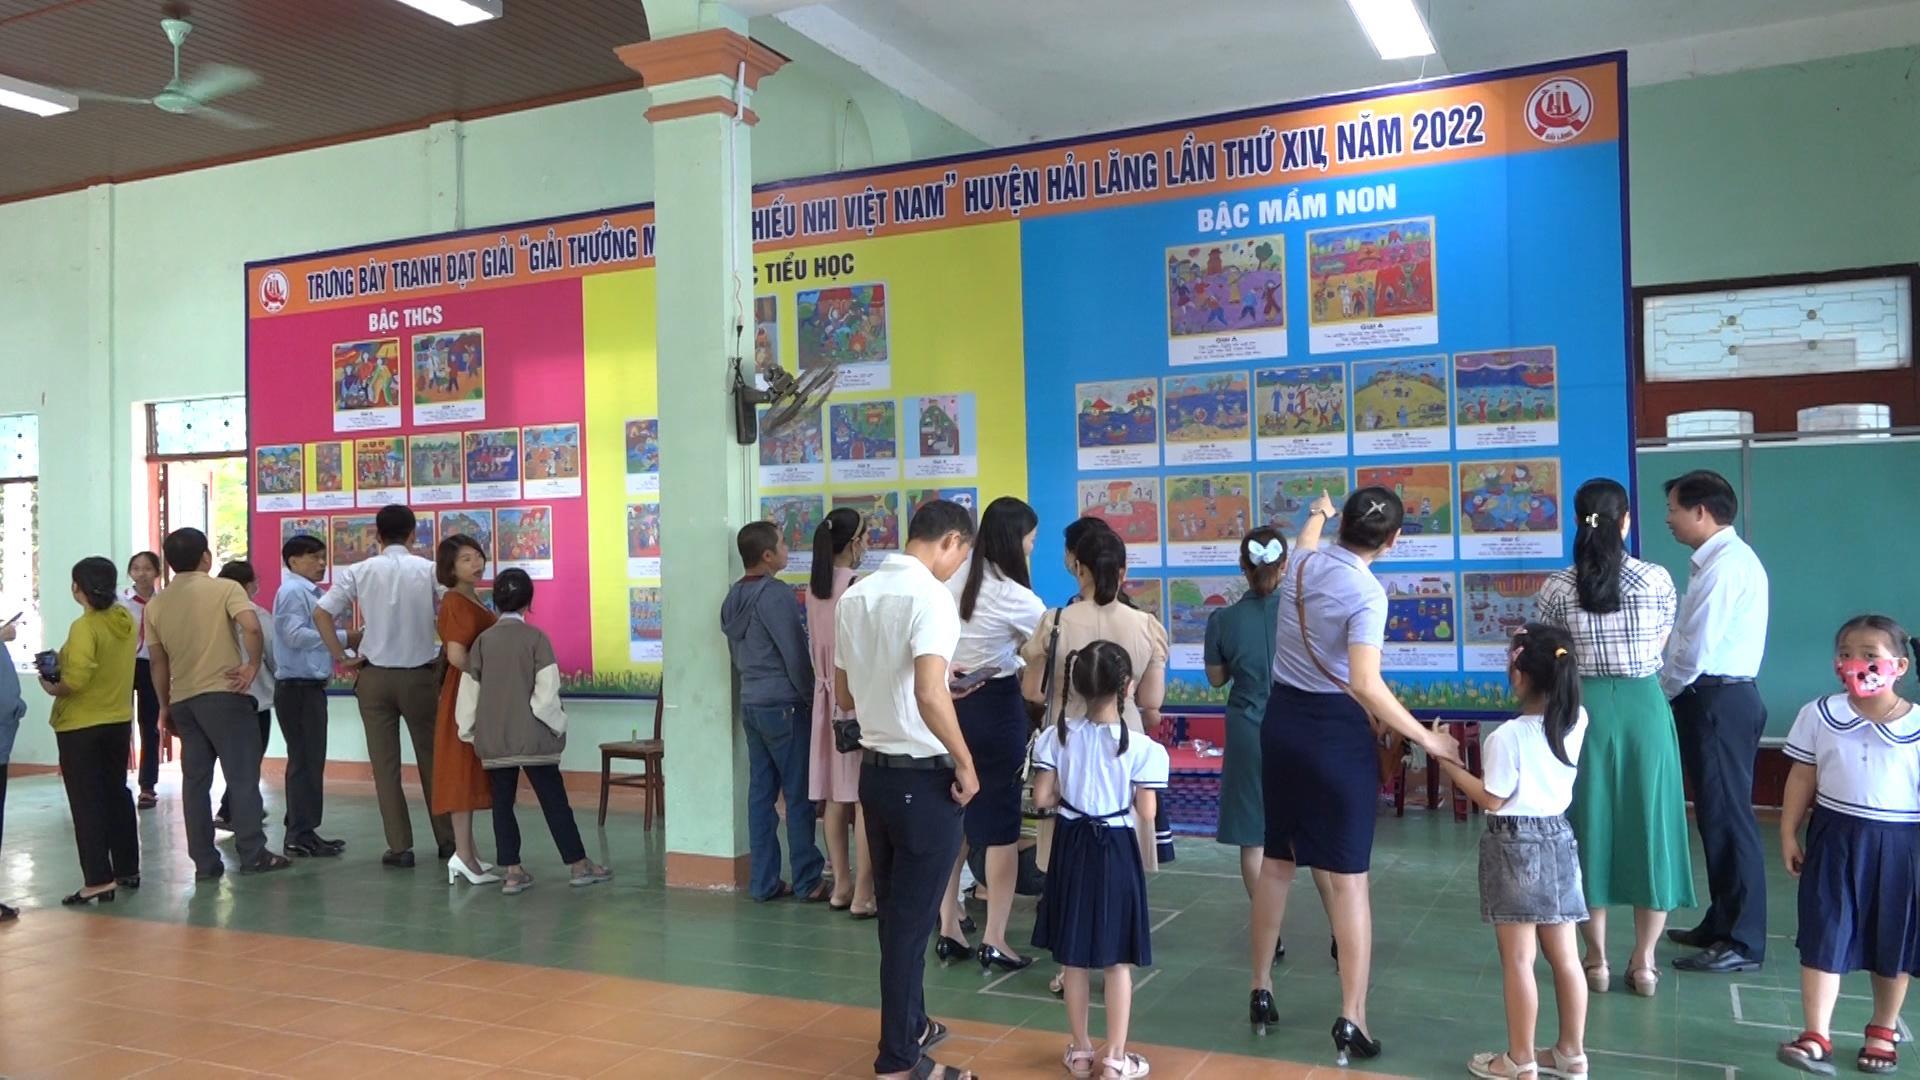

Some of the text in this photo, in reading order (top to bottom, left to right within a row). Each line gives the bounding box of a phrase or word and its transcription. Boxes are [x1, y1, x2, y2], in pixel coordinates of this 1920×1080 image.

[307, 268, 354, 301] TRƯNG
[359, 259, 387, 295] BÀY
[392, 257, 442, 288] TRANH
[447, 251, 477, 288] ĐẠT
[482, 237, 514, 279] GIẢI
[568, 221, 637, 266] THƯỞNG
[752, 195, 796, 240] HIẾU
[803, 199, 837, 234] NHI
[845, 187, 887, 234] VIỆT
[964, 165, 1039, 214] HUYỆN
[1047, 153, 1085, 201] HẢI
[1094, 151, 1157, 194] LĂNG
[1166, 134, 1215, 186] LẦN
[1223, 127, 1275, 178] THỨ
[1282, 127, 1328, 170] XIV,
[1337, 113, 1402, 161] NĂM
[1412, 104, 1484, 151] 2022
[1197, 183, 1397, 236] BẬC MẦM NON
[765, 251, 807, 284] TIỂU
[814, 253, 854, 280] HỌC
[369, 305, 443, 334] BẬC THCS
